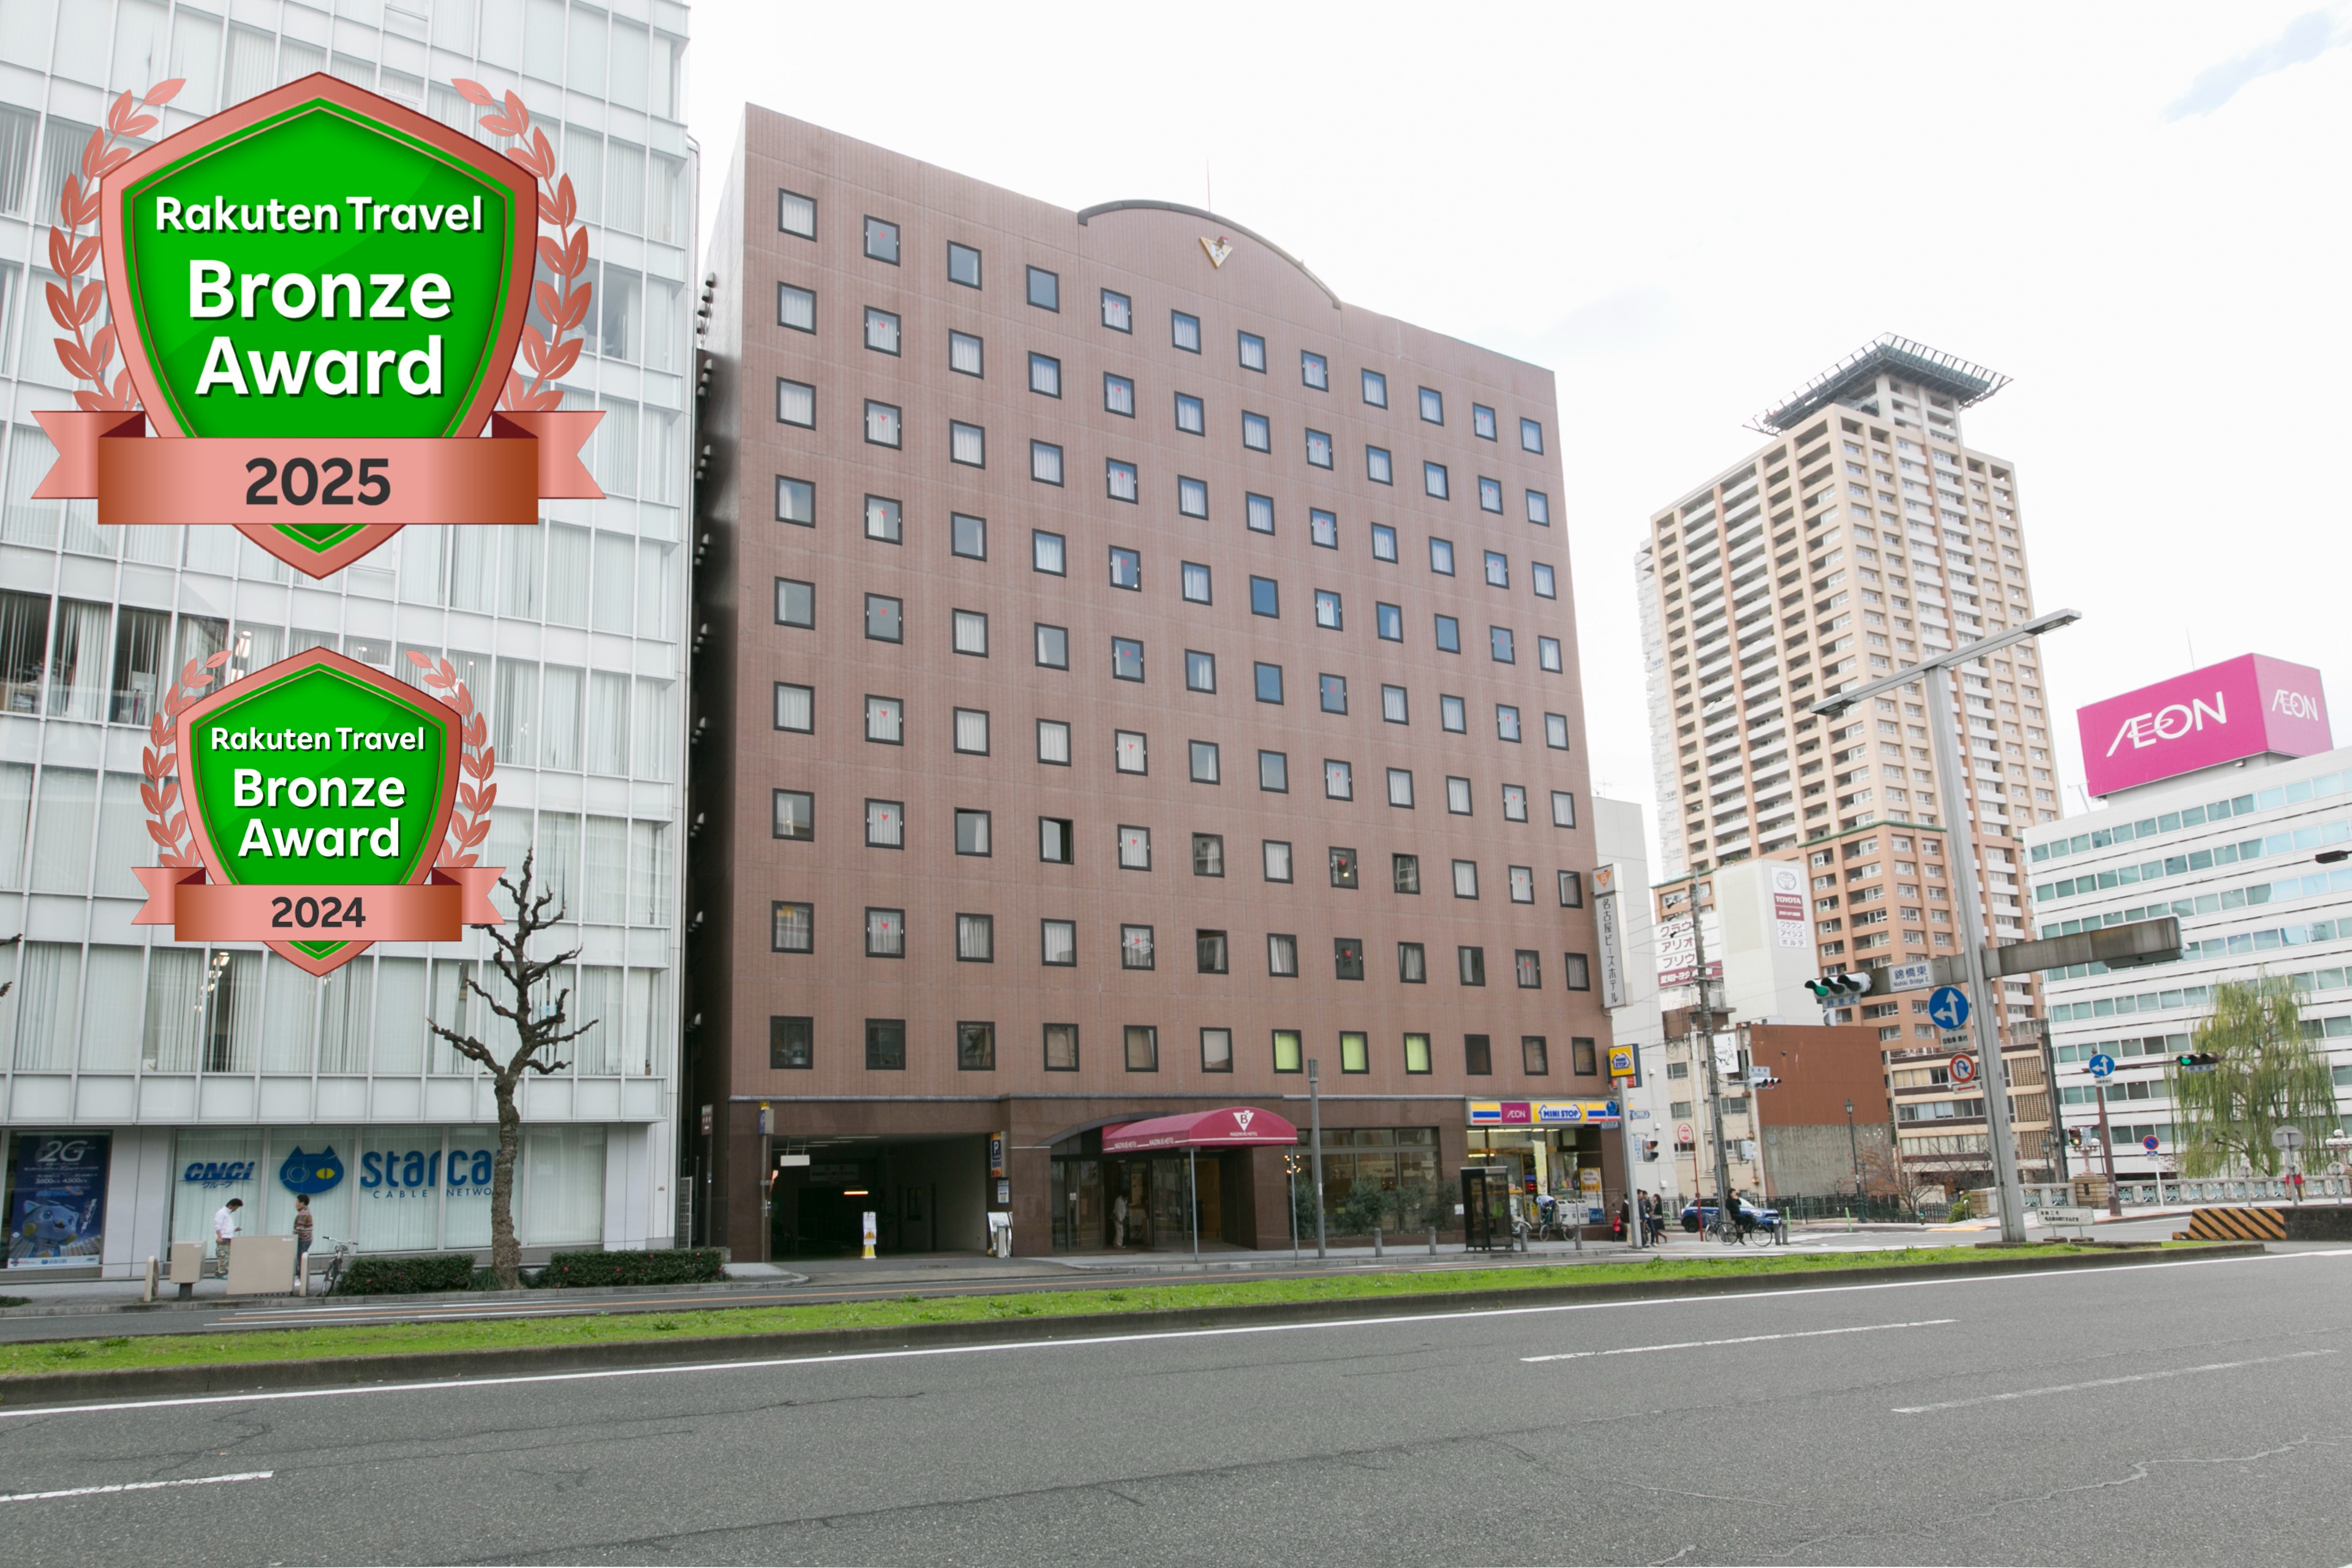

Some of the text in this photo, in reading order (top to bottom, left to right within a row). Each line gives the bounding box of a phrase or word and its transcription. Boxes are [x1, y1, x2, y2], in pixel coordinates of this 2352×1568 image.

[1660, 920, 1702, 938] クラウ
[1662, 937, 1703, 953] アリオ
[1894, 965, 1927, 980] 錦橋東
[38, 1140, 88, 1162] 2G
[993, 1141, 999, 1154] P
[373, 1188, 492, 1199] CABLE NETWO
